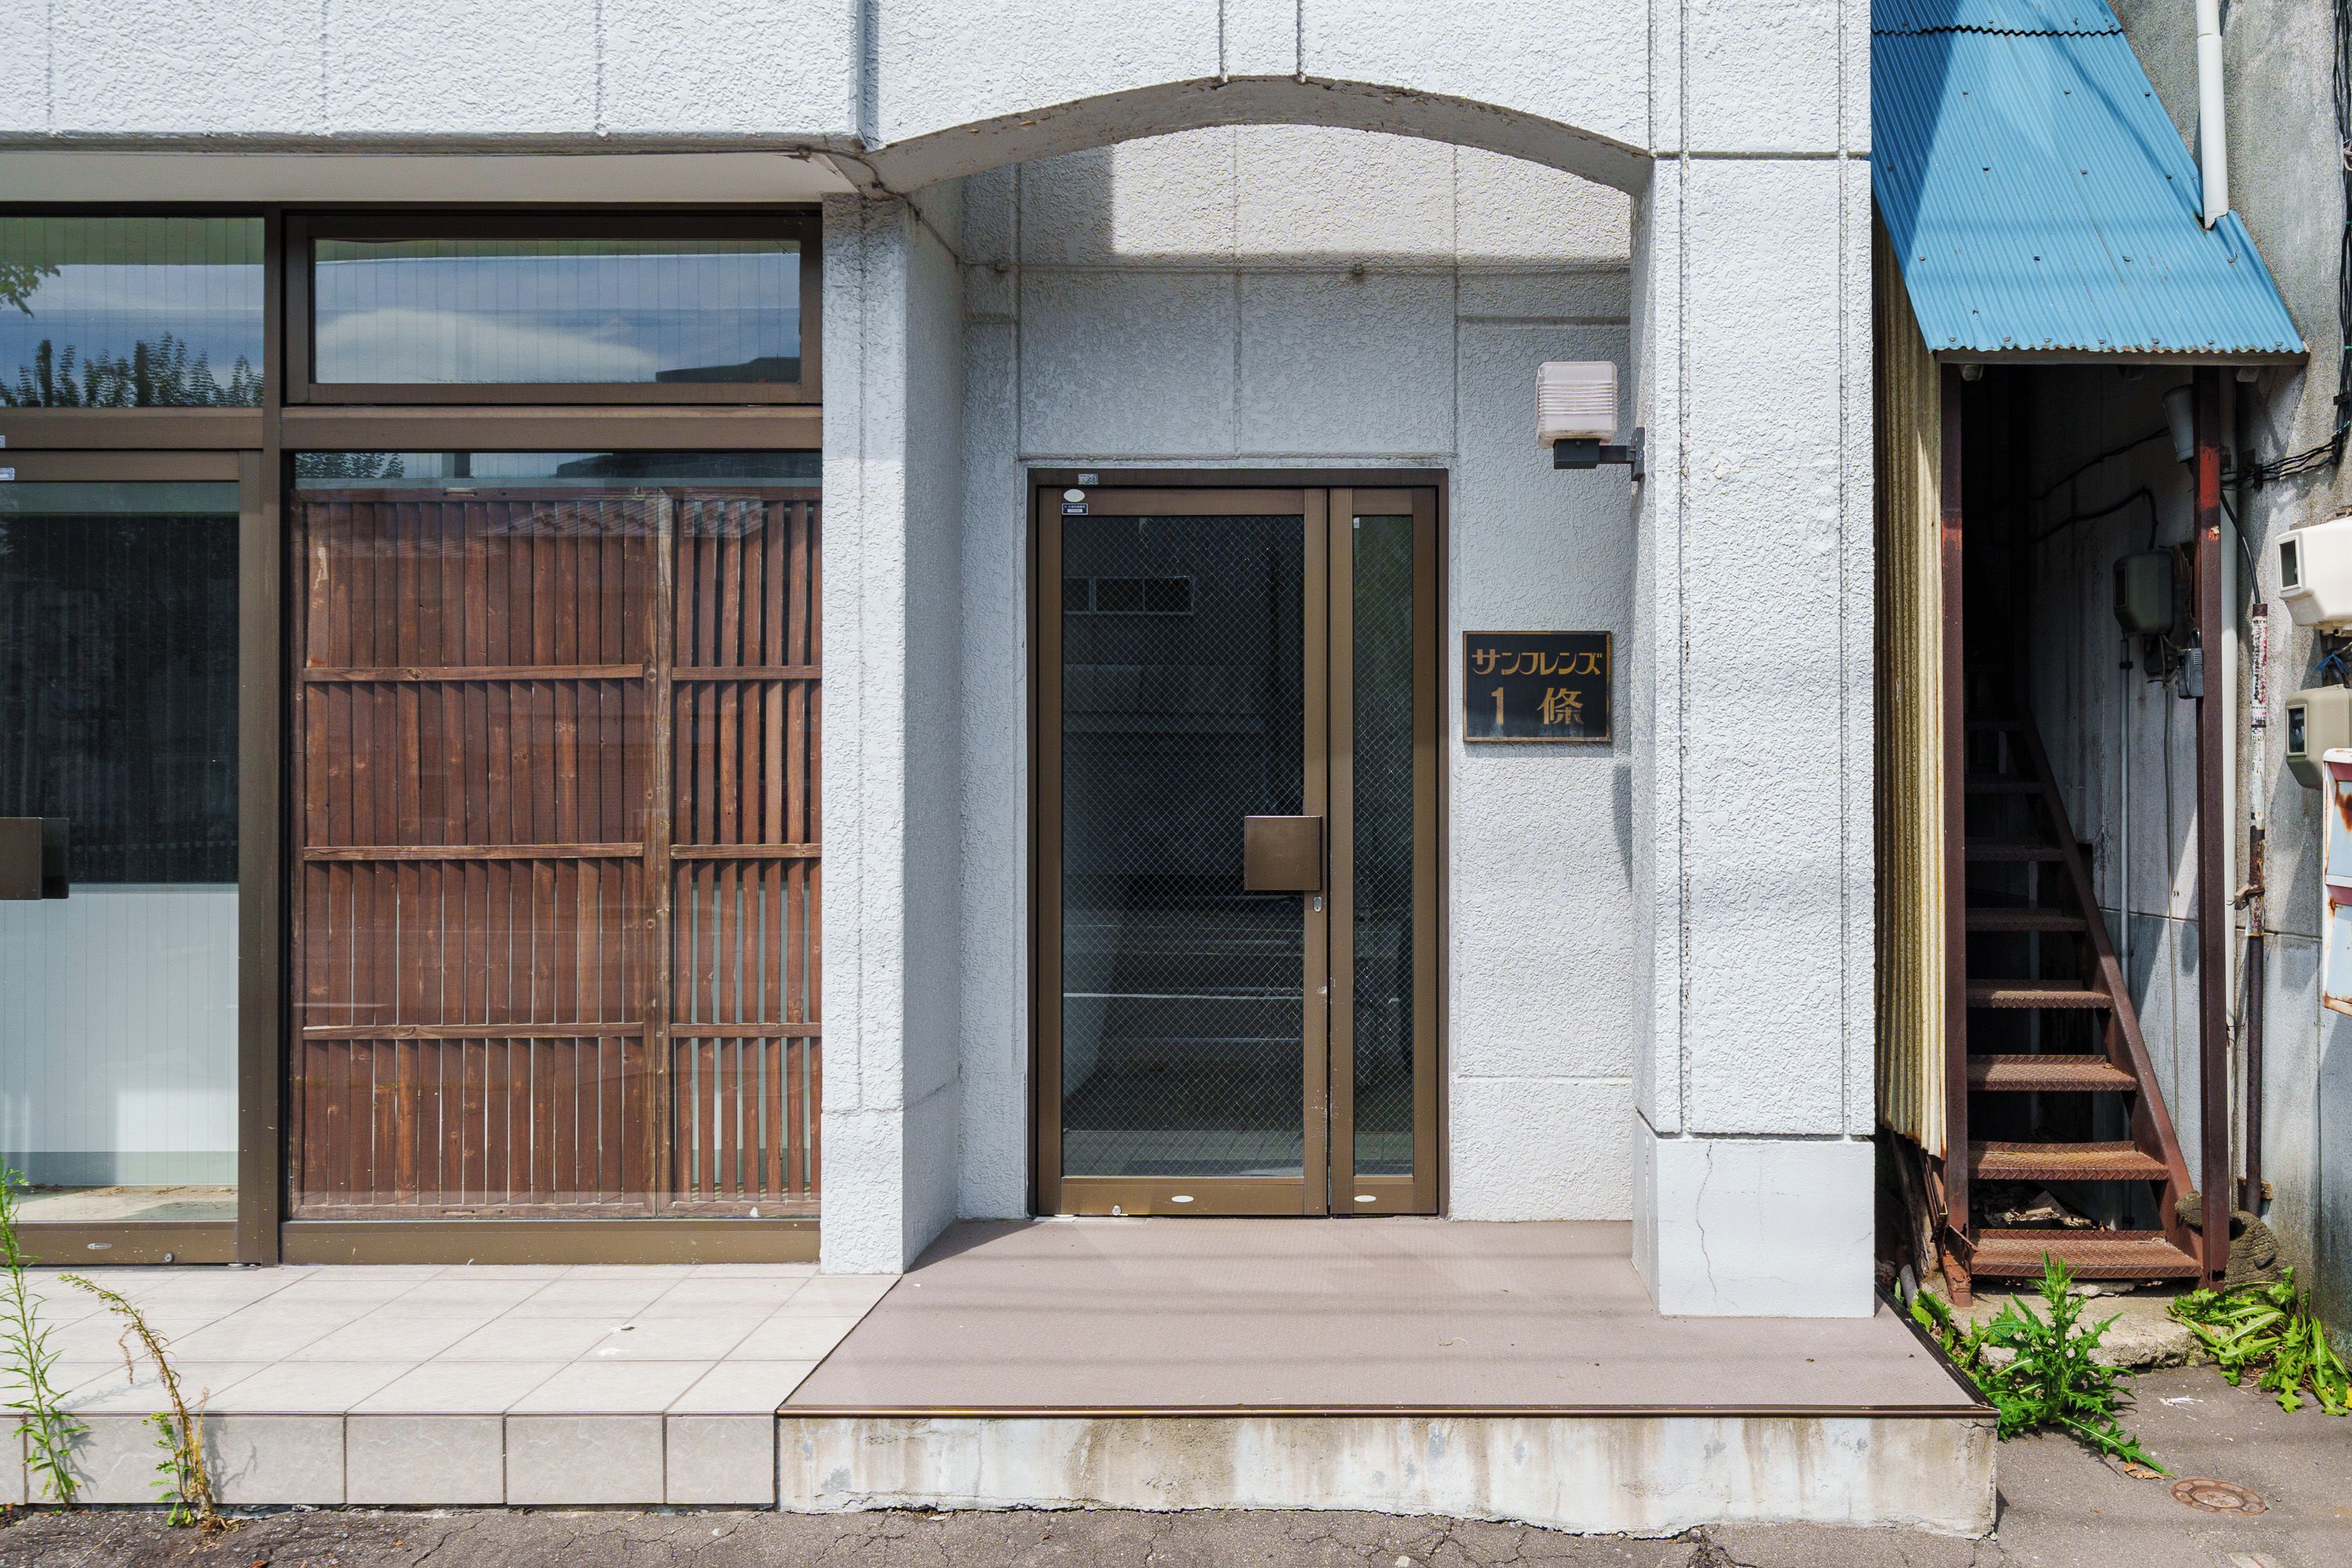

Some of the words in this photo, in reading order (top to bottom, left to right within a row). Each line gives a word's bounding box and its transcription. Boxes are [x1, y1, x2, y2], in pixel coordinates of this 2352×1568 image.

[1472, 648, 1602, 675] サンフレンズ
